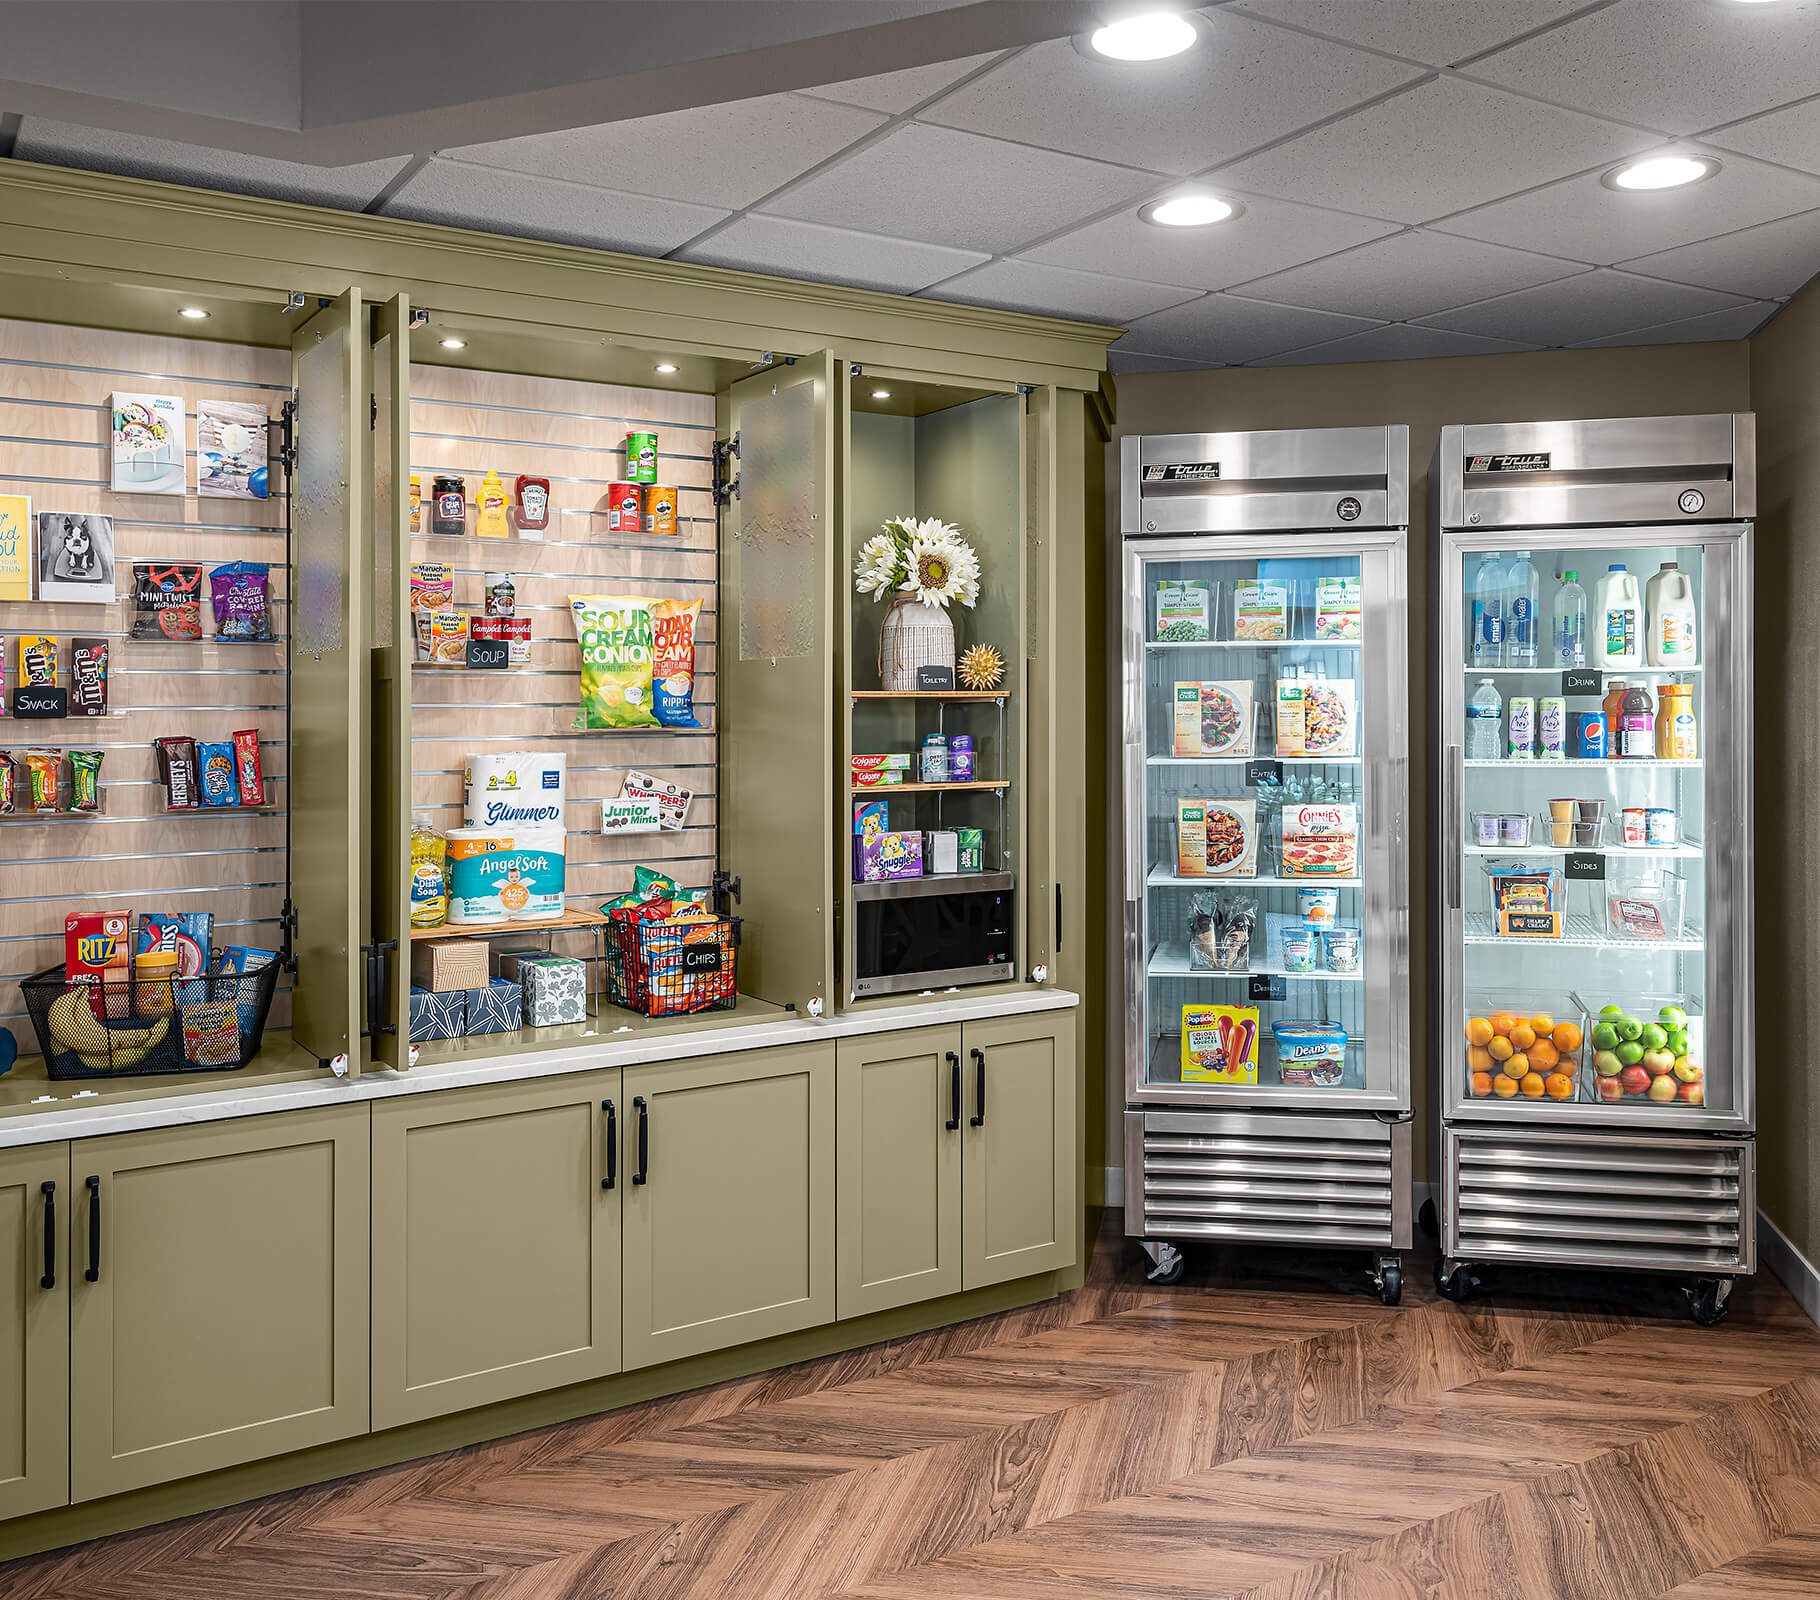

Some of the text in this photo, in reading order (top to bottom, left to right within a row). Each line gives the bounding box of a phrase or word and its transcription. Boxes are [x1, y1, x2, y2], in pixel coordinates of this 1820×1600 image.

[140, 592, 194, 603] MINI TWIST
[581, 609, 651, 633] SOUR
[1492, 616, 1500, 643] smart
[582, 630, 653, 649] CREAM
[654, 632, 692, 650] OUR
[471, 648, 505, 663] SOUP
[654, 645, 691, 662] EAM
[1568, 676, 1596, 688] DRINK
[17, 695, 58, 711] SNACK
[851, 756, 882, 766] Colgate
[170, 759, 188, 806] HERSHEY'S
[489, 775, 497, 787] 2
[505, 770, 517, 787] 4
[858, 772, 881, 781] Colgate
[484, 801, 560, 826] Glimmer
[604, 804, 650, 818] Junior
[630, 815, 658, 825] Mints
[485, 841, 497, 851] 16
[480, 855, 549, 876] Angel Soft
[878, 855, 911, 872] Snuggle
[1572, 859, 1598, 871] SIDES
[418, 879, 437, 888] Dish
[417, 887, 438, 897] Soap
[505, 887, 524, 897] 425
[112, 920, 118, 928] 8
[77, 937, 117, 961] RITZ
[687, 953, 716, 966] CHIPS
[1294, 1043, 1328, 1057] Dean's
